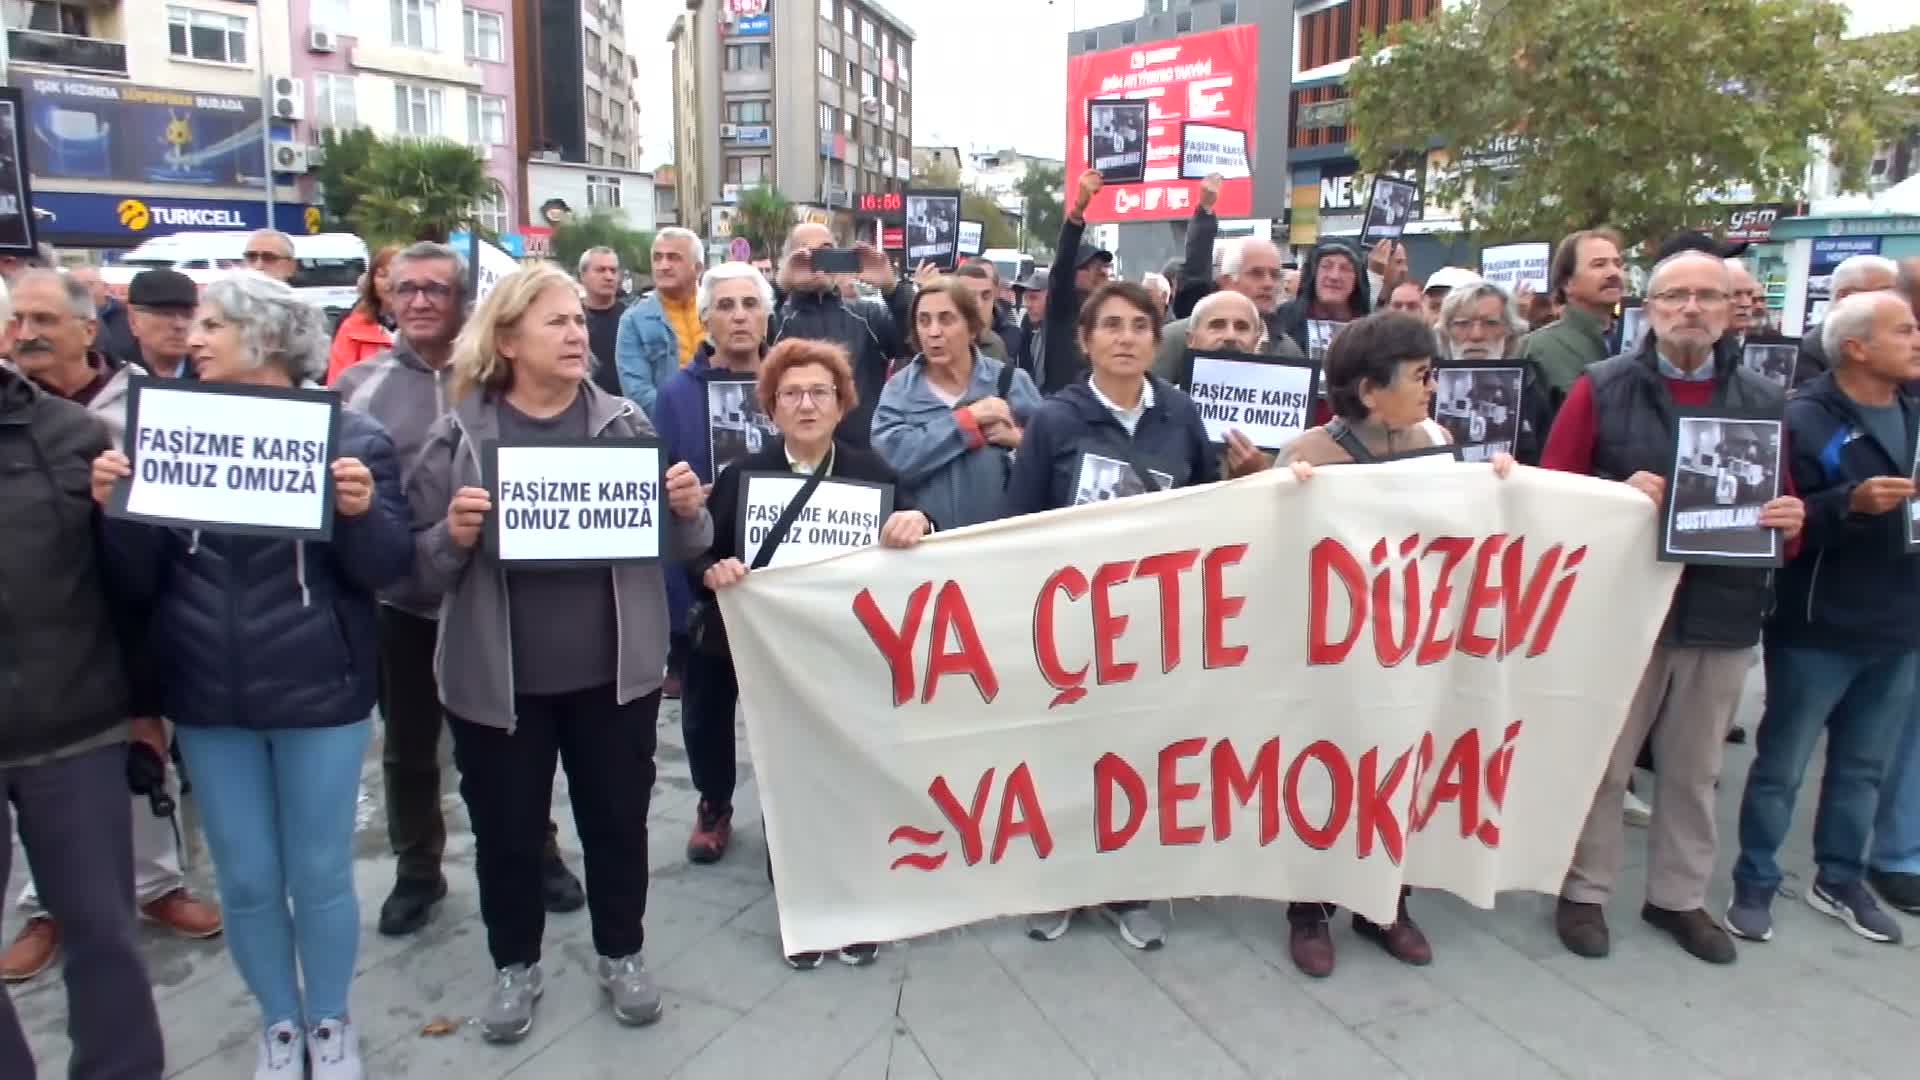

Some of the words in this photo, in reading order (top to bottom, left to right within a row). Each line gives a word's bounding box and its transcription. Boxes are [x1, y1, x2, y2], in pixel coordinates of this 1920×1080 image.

[150, 207, 246, 227] TURKCELL
[1731, 208, 1777, 230] gsm
[1192, 381, 1257, 404] FAŞİZME
[1262, 389, 1307, 411] KARŞI
[1244, 407, 1300, 428] OMUZA
[139, 426, 245, 459] FAŞİZME
[252, 436, 325, 465] KARŞI
[142, 458, 218, 488] OMUZ
[227, 465, 317, 494] OMUZA
[500, 476, 591, 507] FAŞİZME
[598, 481, 657, 506] KARŞI
[505, 508, 570, 530] OMUZ
[578, 508, 653, 530] OMUZA
[748, 501, 822, 526] FAŞME
[828, 508, 878, 531] KARŞI
[808, 527, 872, 547] OMUZA
[852, 579, 999, 708] YA
[1032, 542, 1249, 710] ÇETE
[928, 760, 1053, 867] YA
